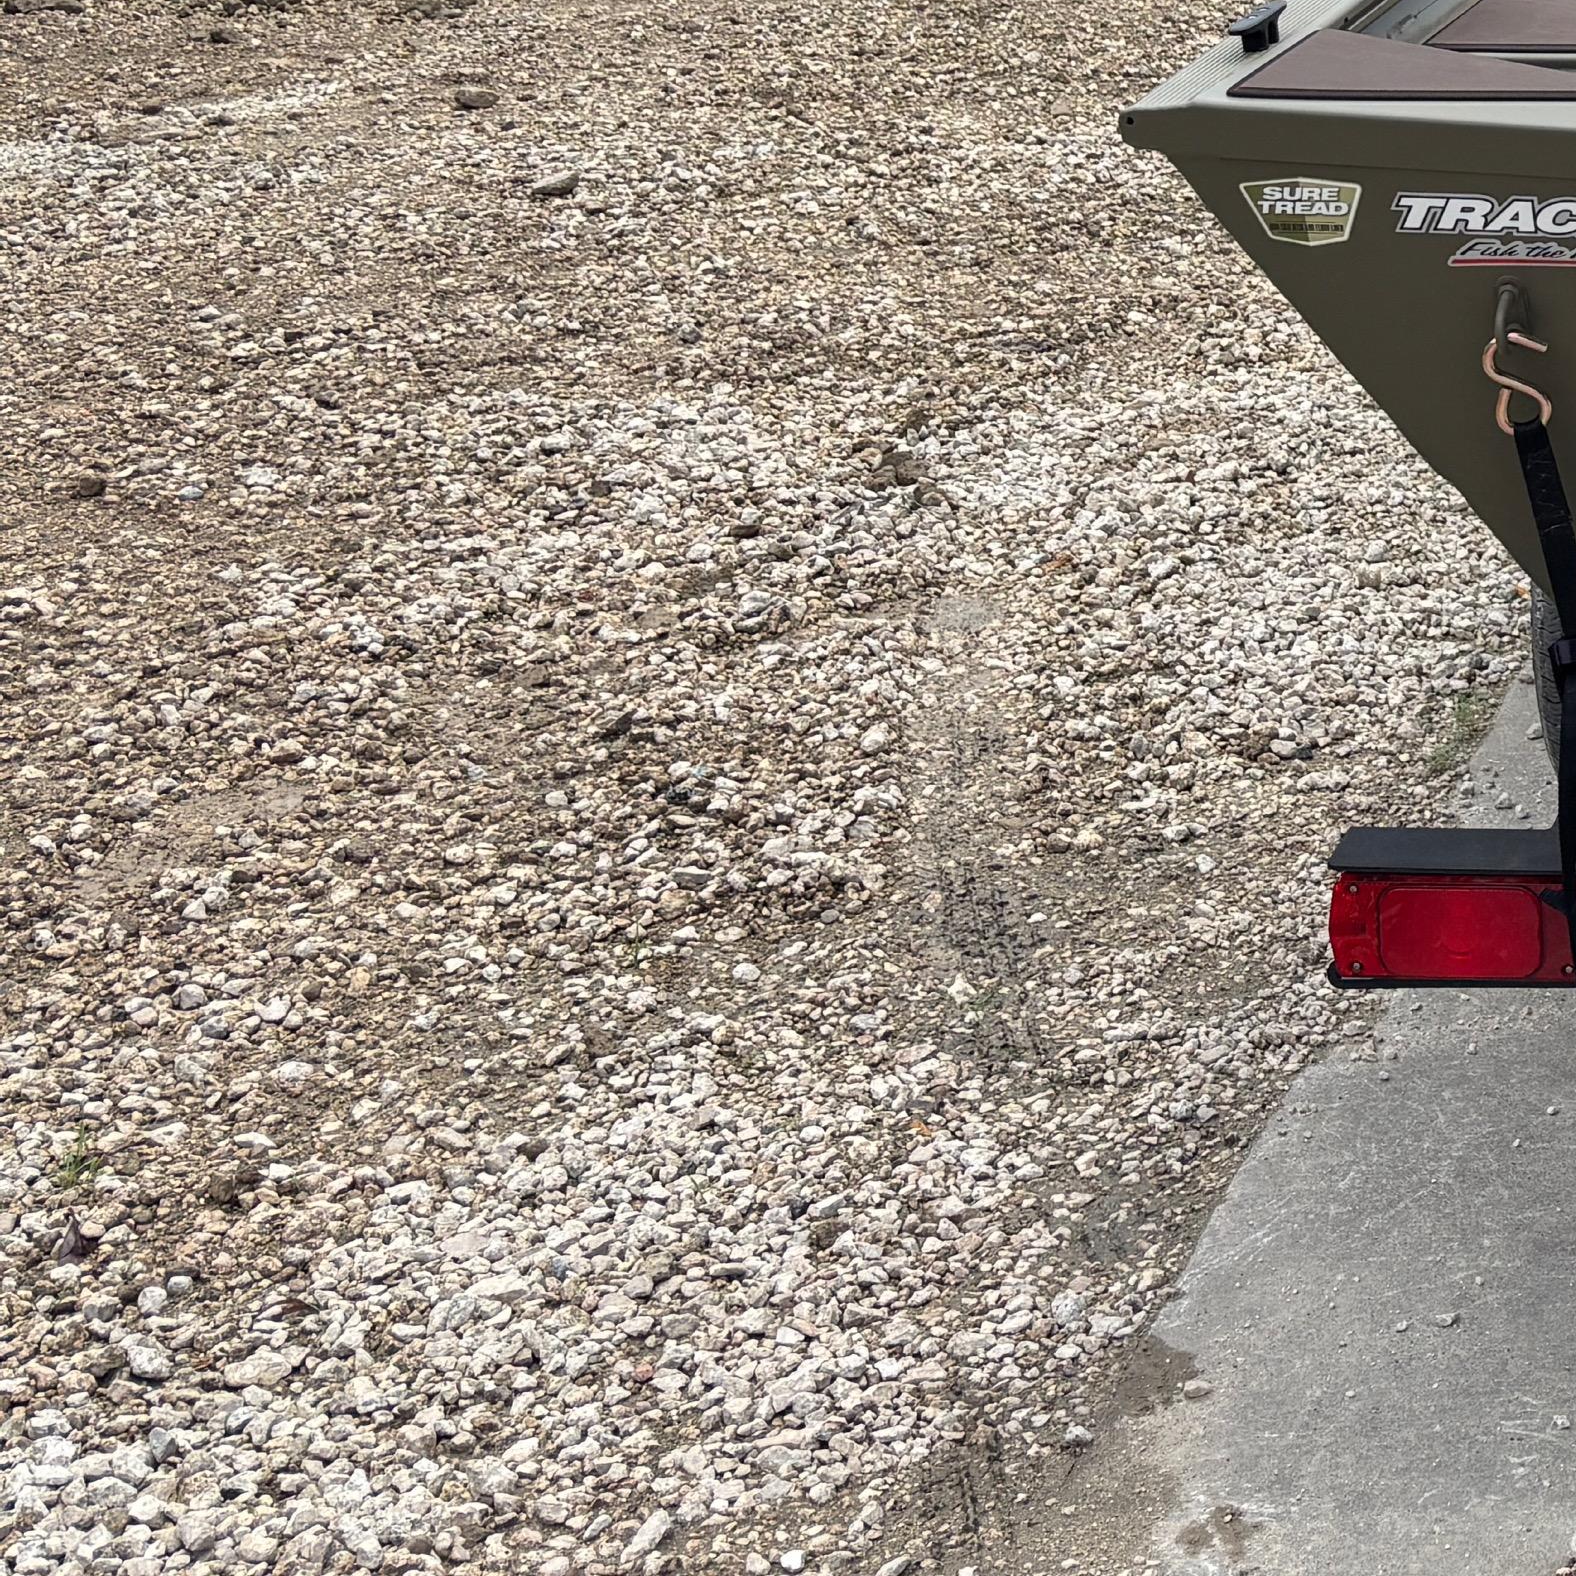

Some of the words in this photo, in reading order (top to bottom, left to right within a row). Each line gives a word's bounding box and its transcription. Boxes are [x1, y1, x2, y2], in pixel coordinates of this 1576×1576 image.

[1262, 186, 1340, 201] SURE
[1257, 200, 1350, 217] TREAD
[1459, 241, 1520, 257] Fish
[1523, 242, 1567, 259] the
